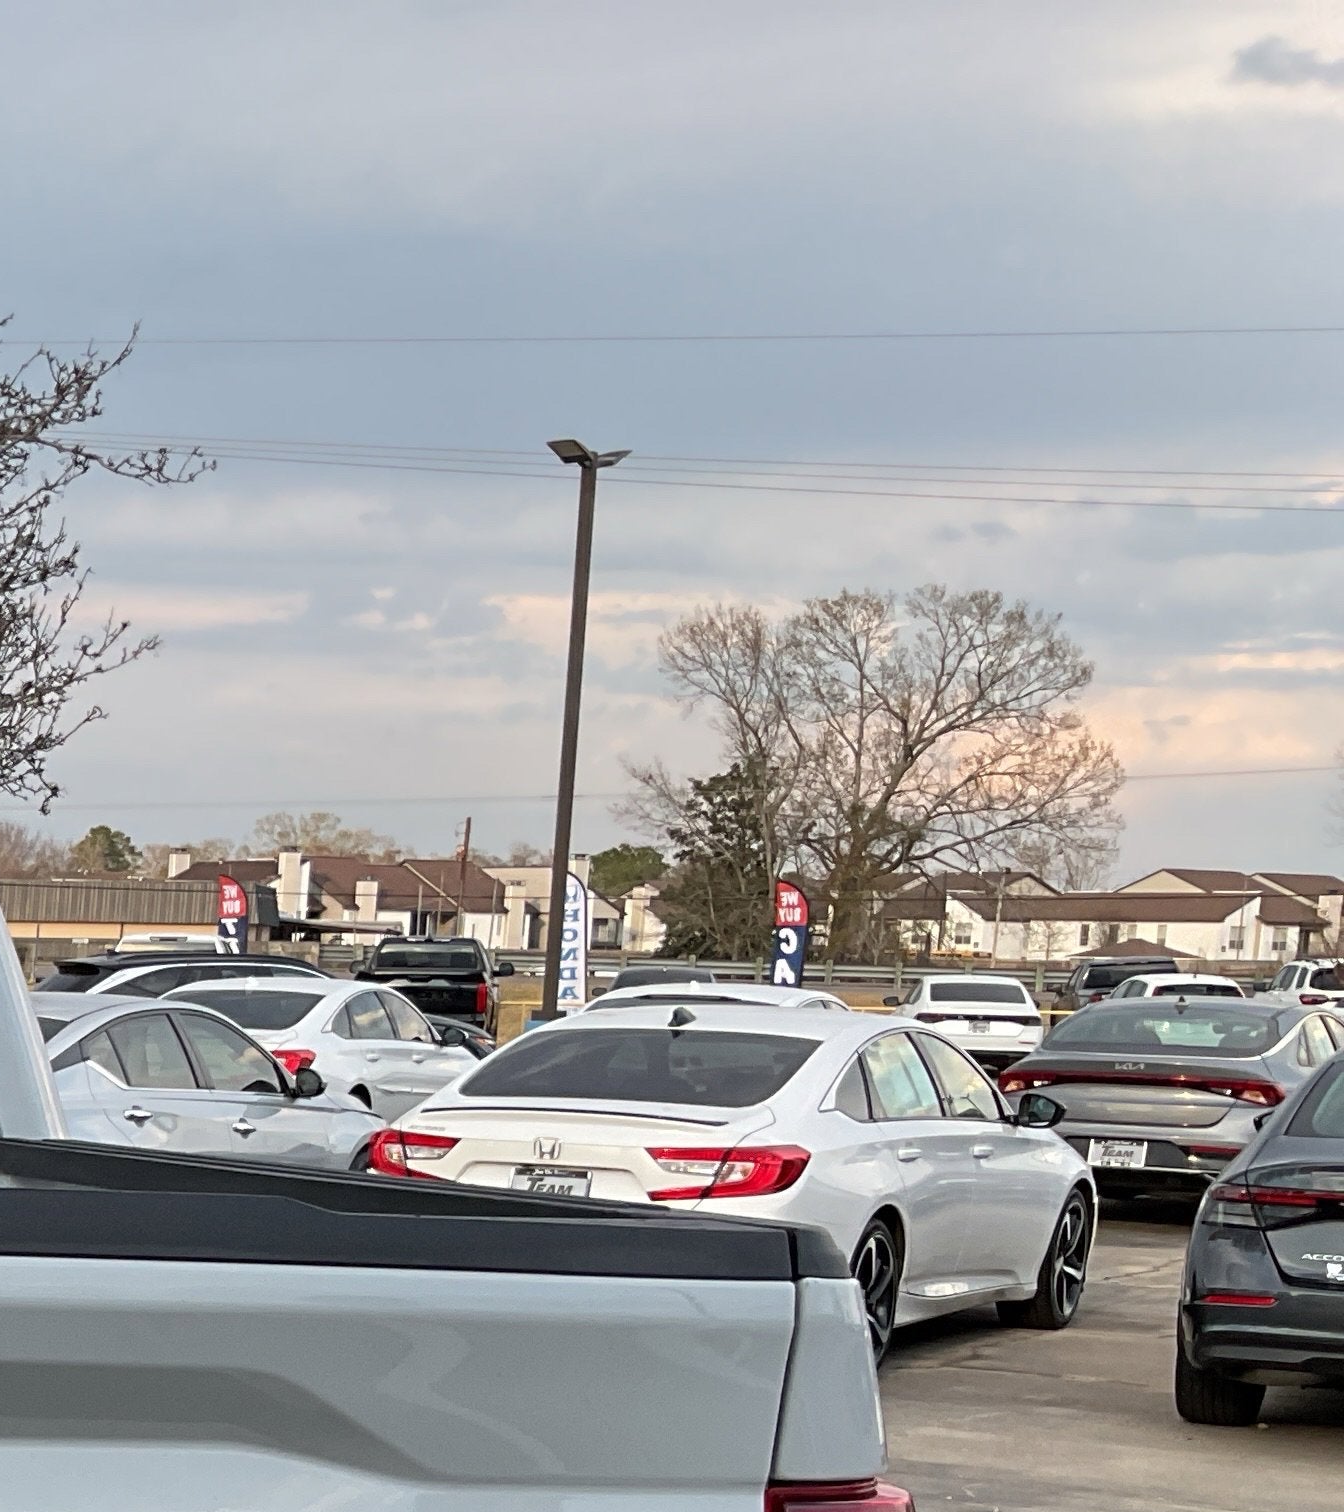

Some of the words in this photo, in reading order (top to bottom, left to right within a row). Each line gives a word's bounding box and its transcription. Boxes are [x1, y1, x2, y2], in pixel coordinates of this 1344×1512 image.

[1114, 1062, 1146, 1070] KIA
[1100, 1145, 1135, 1158] TEAM
[526, 1177, 574, 1196] TEAM
